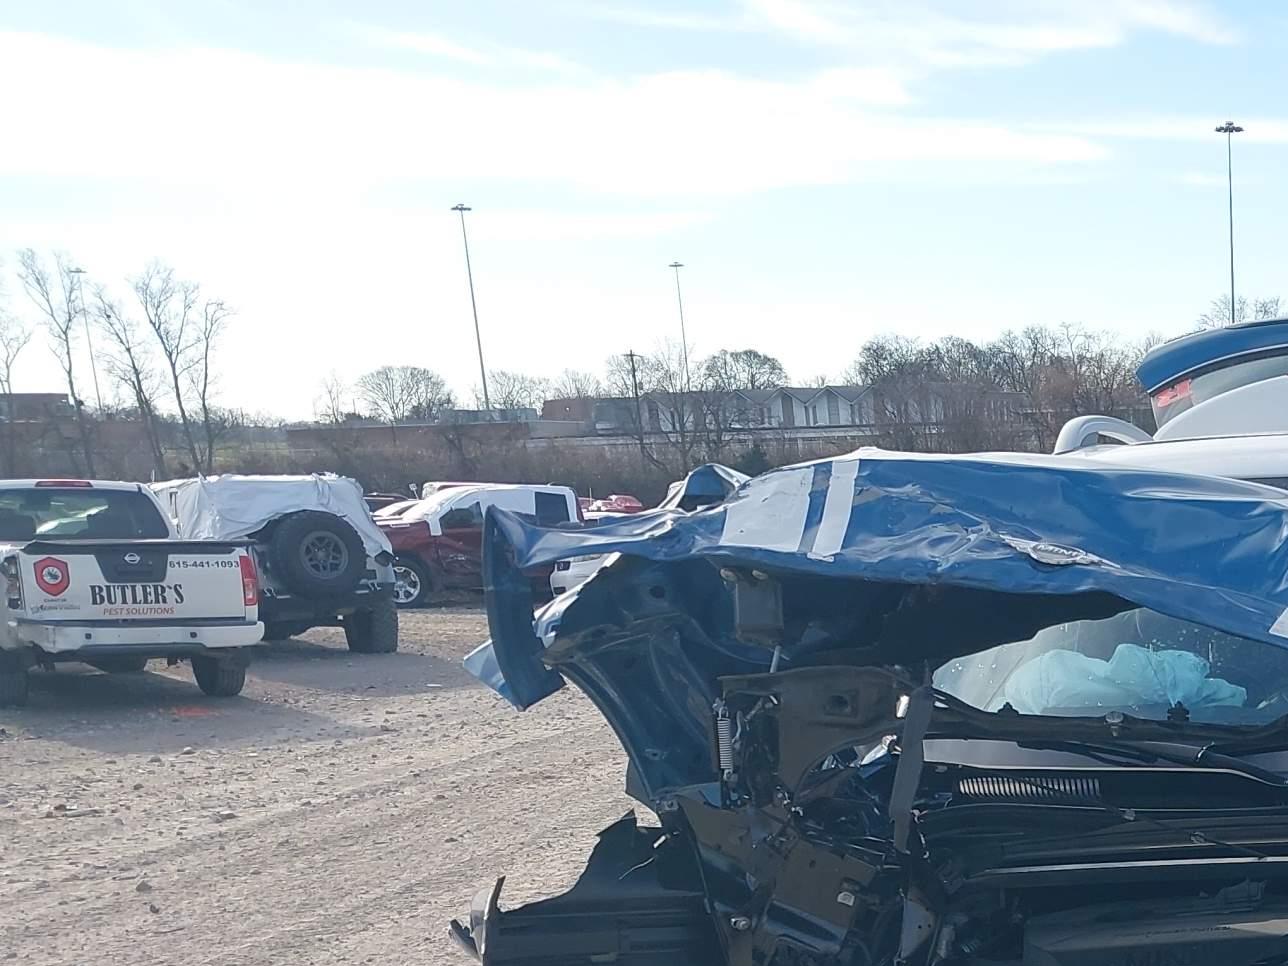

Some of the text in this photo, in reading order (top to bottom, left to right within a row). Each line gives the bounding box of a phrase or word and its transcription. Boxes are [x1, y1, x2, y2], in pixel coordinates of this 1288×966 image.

[169, 560, 240, 569] 615-441-1093
[103, 606, 175, 616] PEST SOLUTIONS
